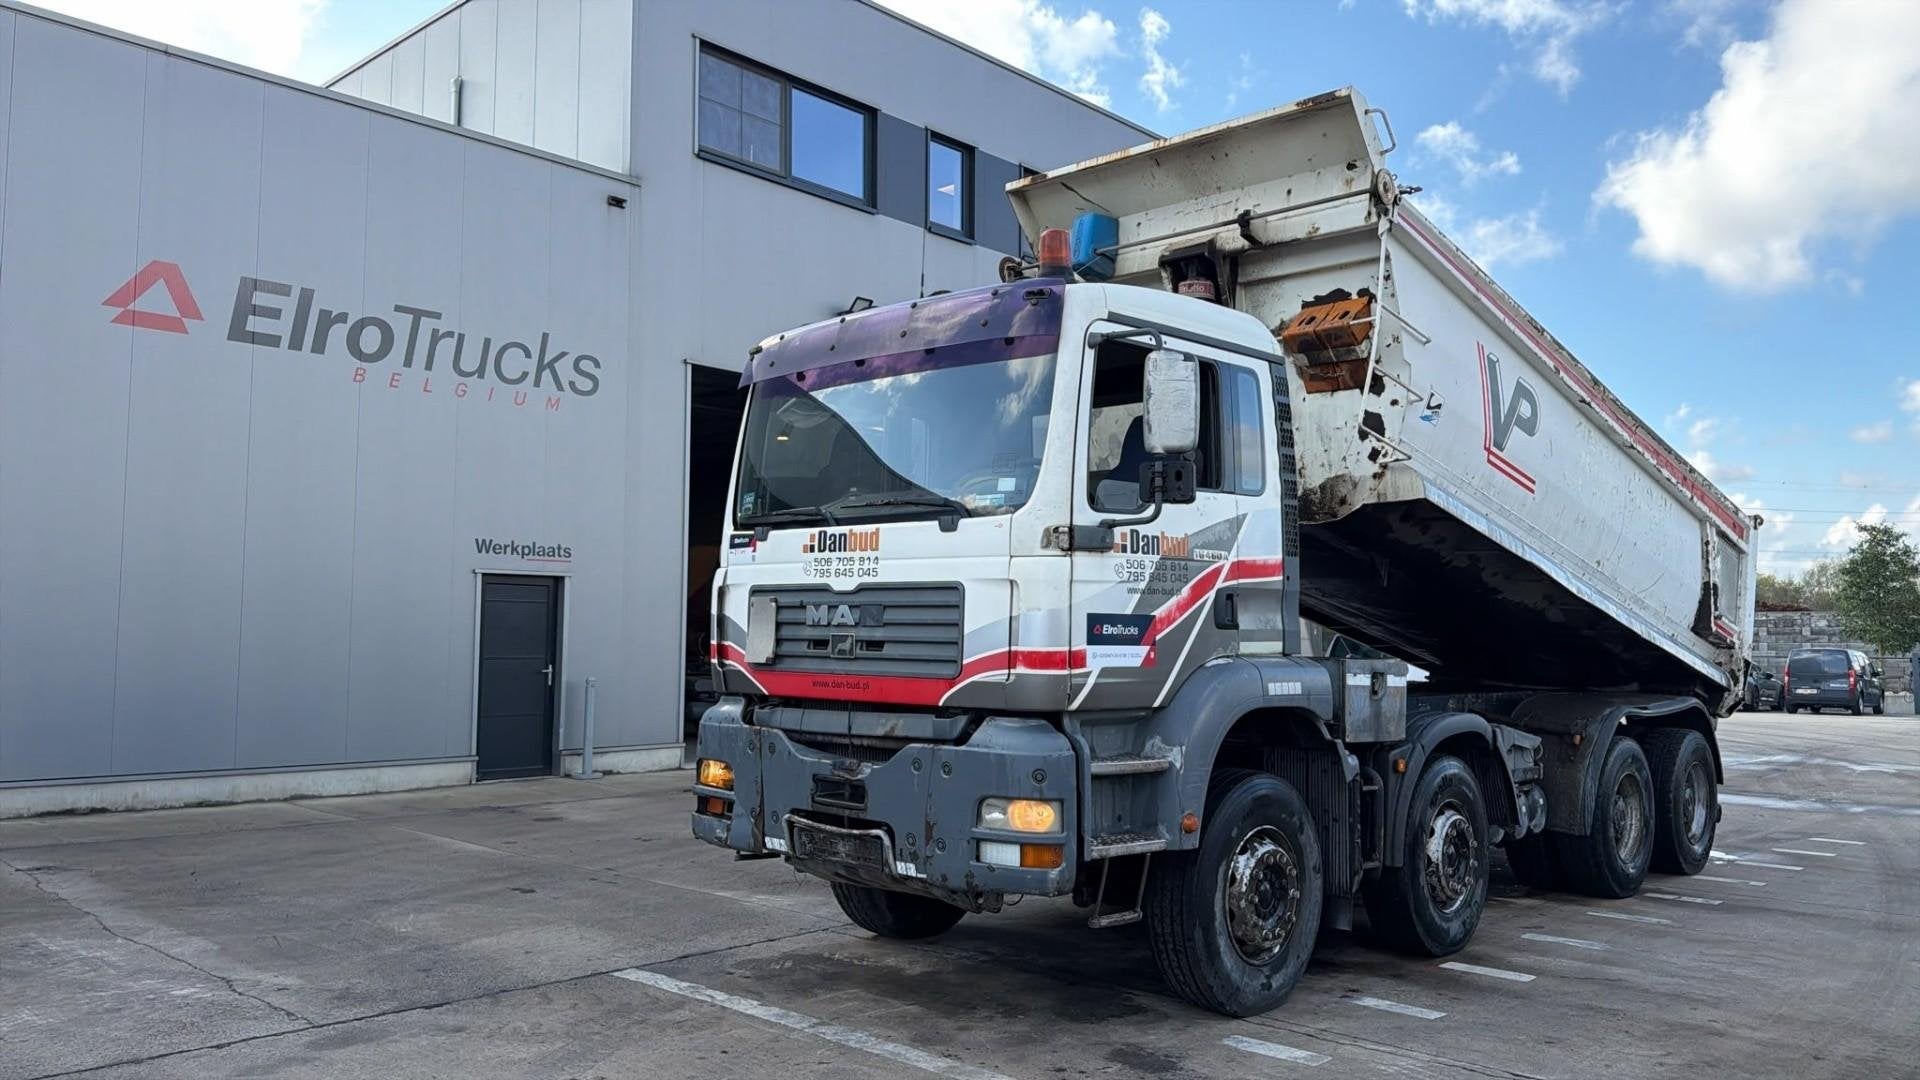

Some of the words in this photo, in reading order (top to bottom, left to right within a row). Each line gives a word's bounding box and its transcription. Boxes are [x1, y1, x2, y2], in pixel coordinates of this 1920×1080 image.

[227, 275, 601, 396] ElroTrucks
[353, 367, 561, 411] BELGIUM
[818, 527, 880, 553] Danbud
[1129, 528, 1189, 557] Danbud
[475, 538, 572, 560] Werkplaats
[813, 557, 832, 567] 506
[836, 557, 855, 566] 705
[859, 556, 879, 566] 814
[1126, 559, 1145, 570] 506
[1148, 560, 1167, 571] 705
[1170, 562, 1188, 572] 814
[813, 568, 831, 578] 795
[835, 568, 854, 578] 645
[858, 567, 878, 578] 045
[1126, 571, 1146, 582] 795
[1170, 573, 1189, 583] 045
[1102, 624, 1139, 635] ElroTrucks
[812, 680, 870, 692] www.dan-bud.pl
